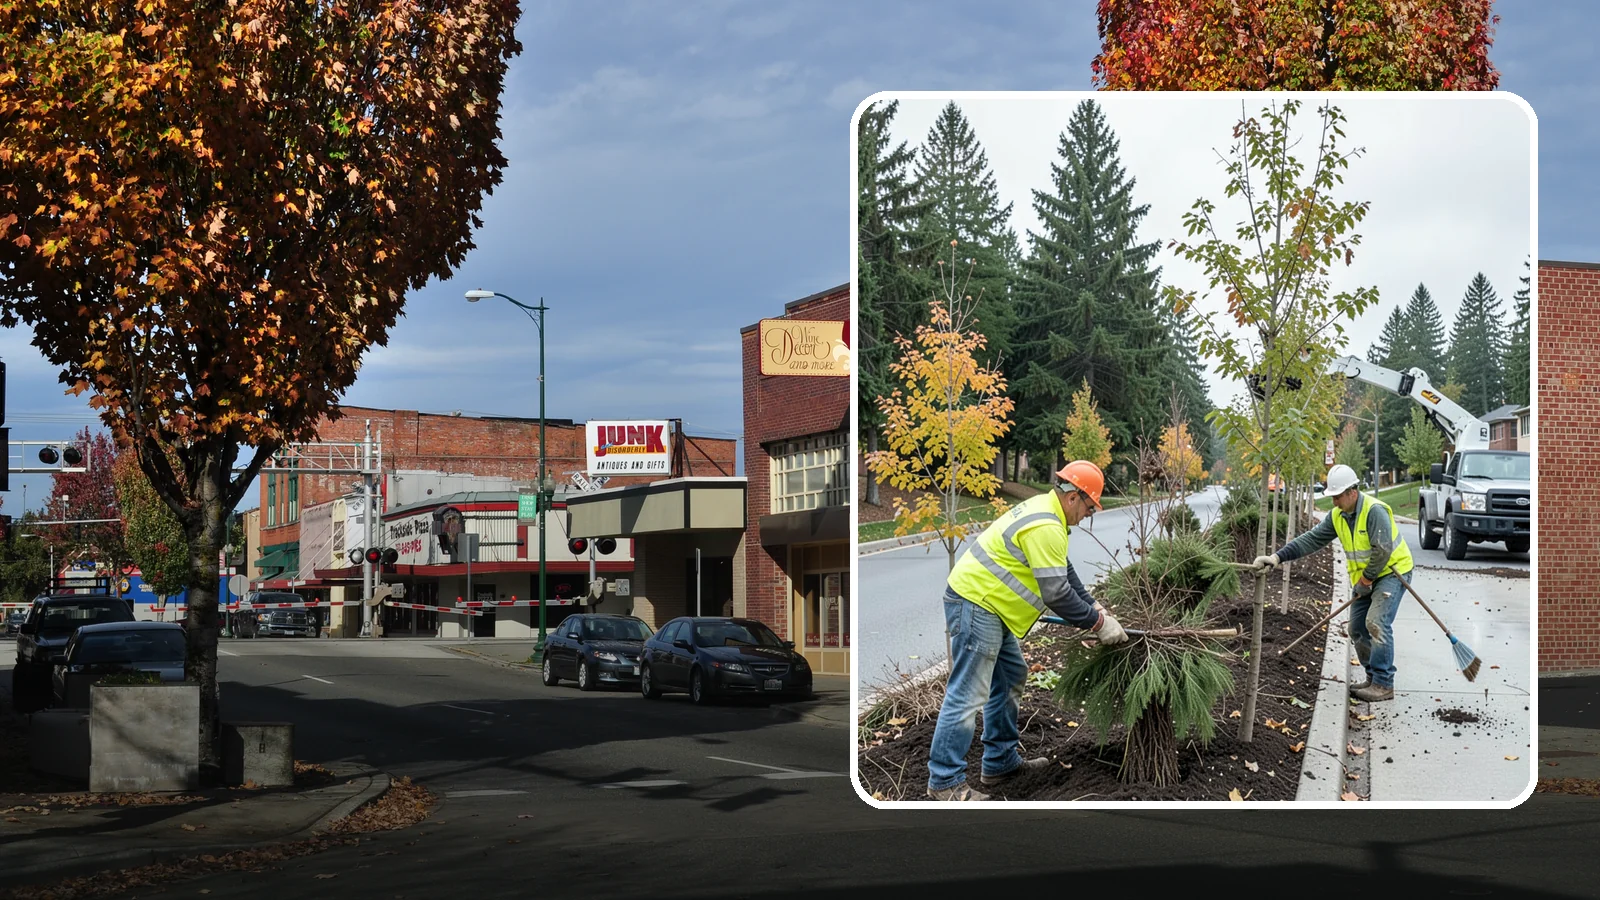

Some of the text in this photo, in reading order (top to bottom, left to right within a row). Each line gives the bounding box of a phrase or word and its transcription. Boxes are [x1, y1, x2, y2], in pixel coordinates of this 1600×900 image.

[595, 425, 665, 457] JUNK
[607, 446, 646, 454] DISORDERLY
[597, 460, 665, 470] ANTIQUES AND GIFTS
[573, 473, 589, 492] RAIL
[414, 519, 429, 535] Pizza
